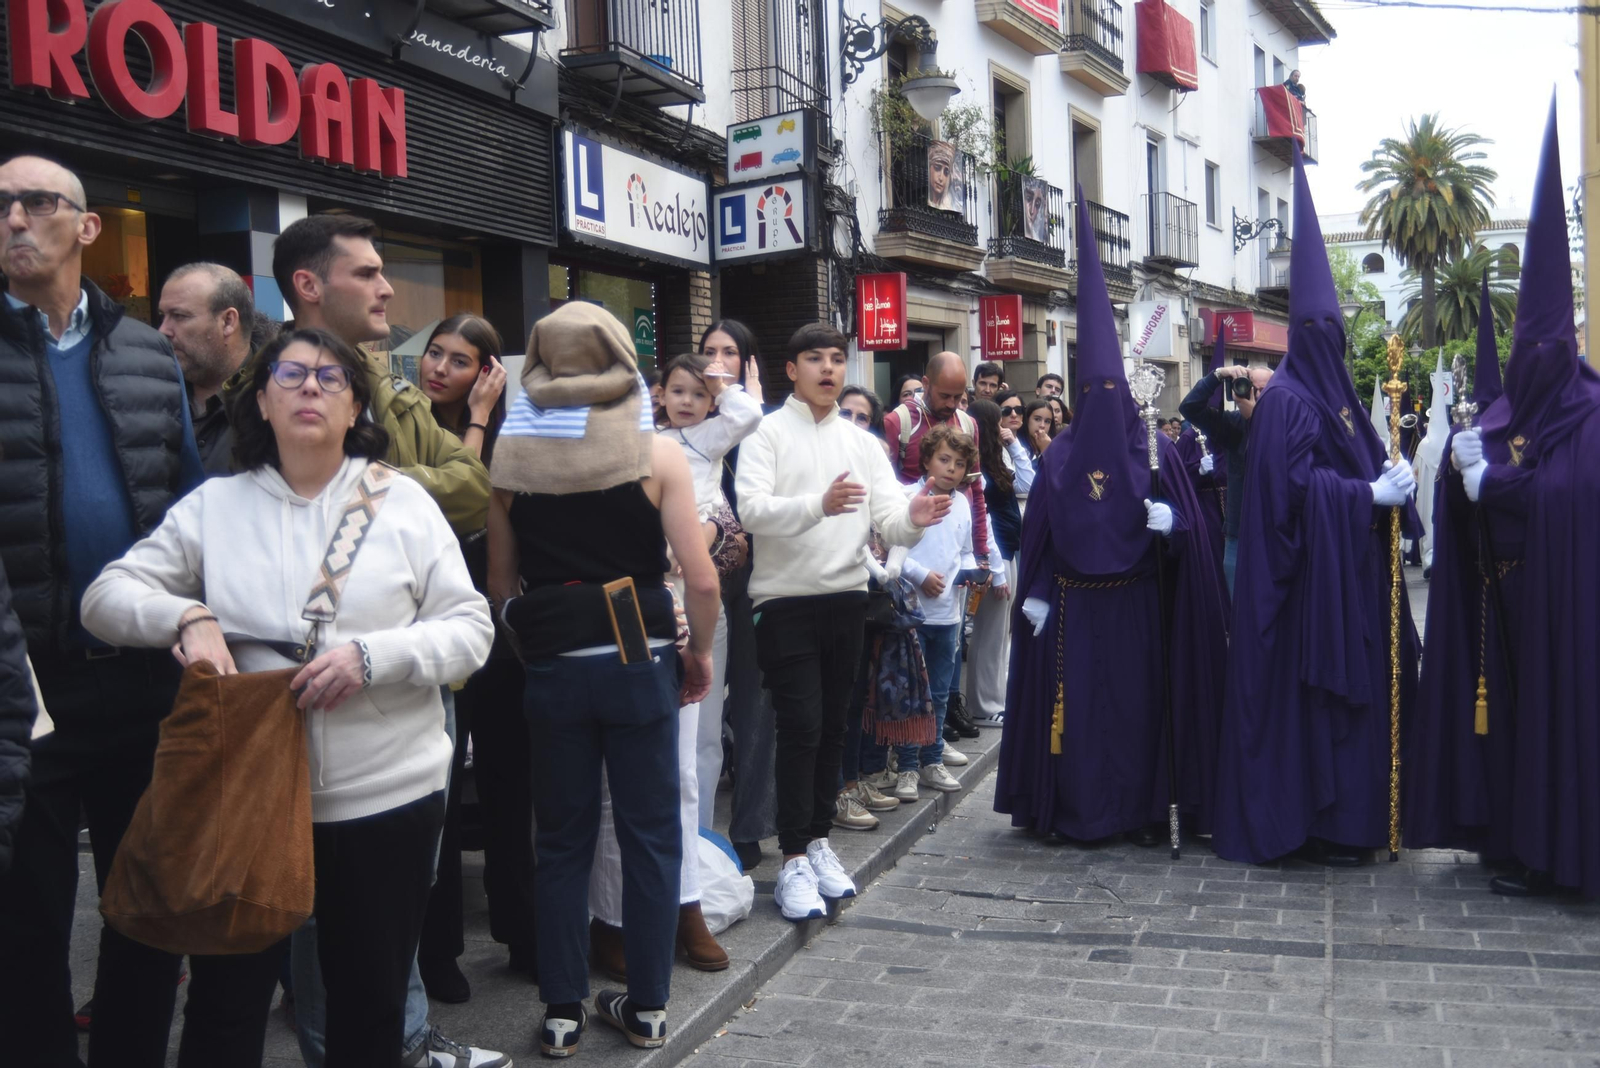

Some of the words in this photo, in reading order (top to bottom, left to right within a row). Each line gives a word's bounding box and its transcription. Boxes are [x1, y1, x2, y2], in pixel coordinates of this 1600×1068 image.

[411, 30, 509, 77] anaderia
[8, 0, 407, 178] ROLDAN
[579, 144, 599, 210] L
[627, 173, 706, 252] Realejo
[725, 206, 741, 235] L
[771, 197, 779, 248] GRUPO
